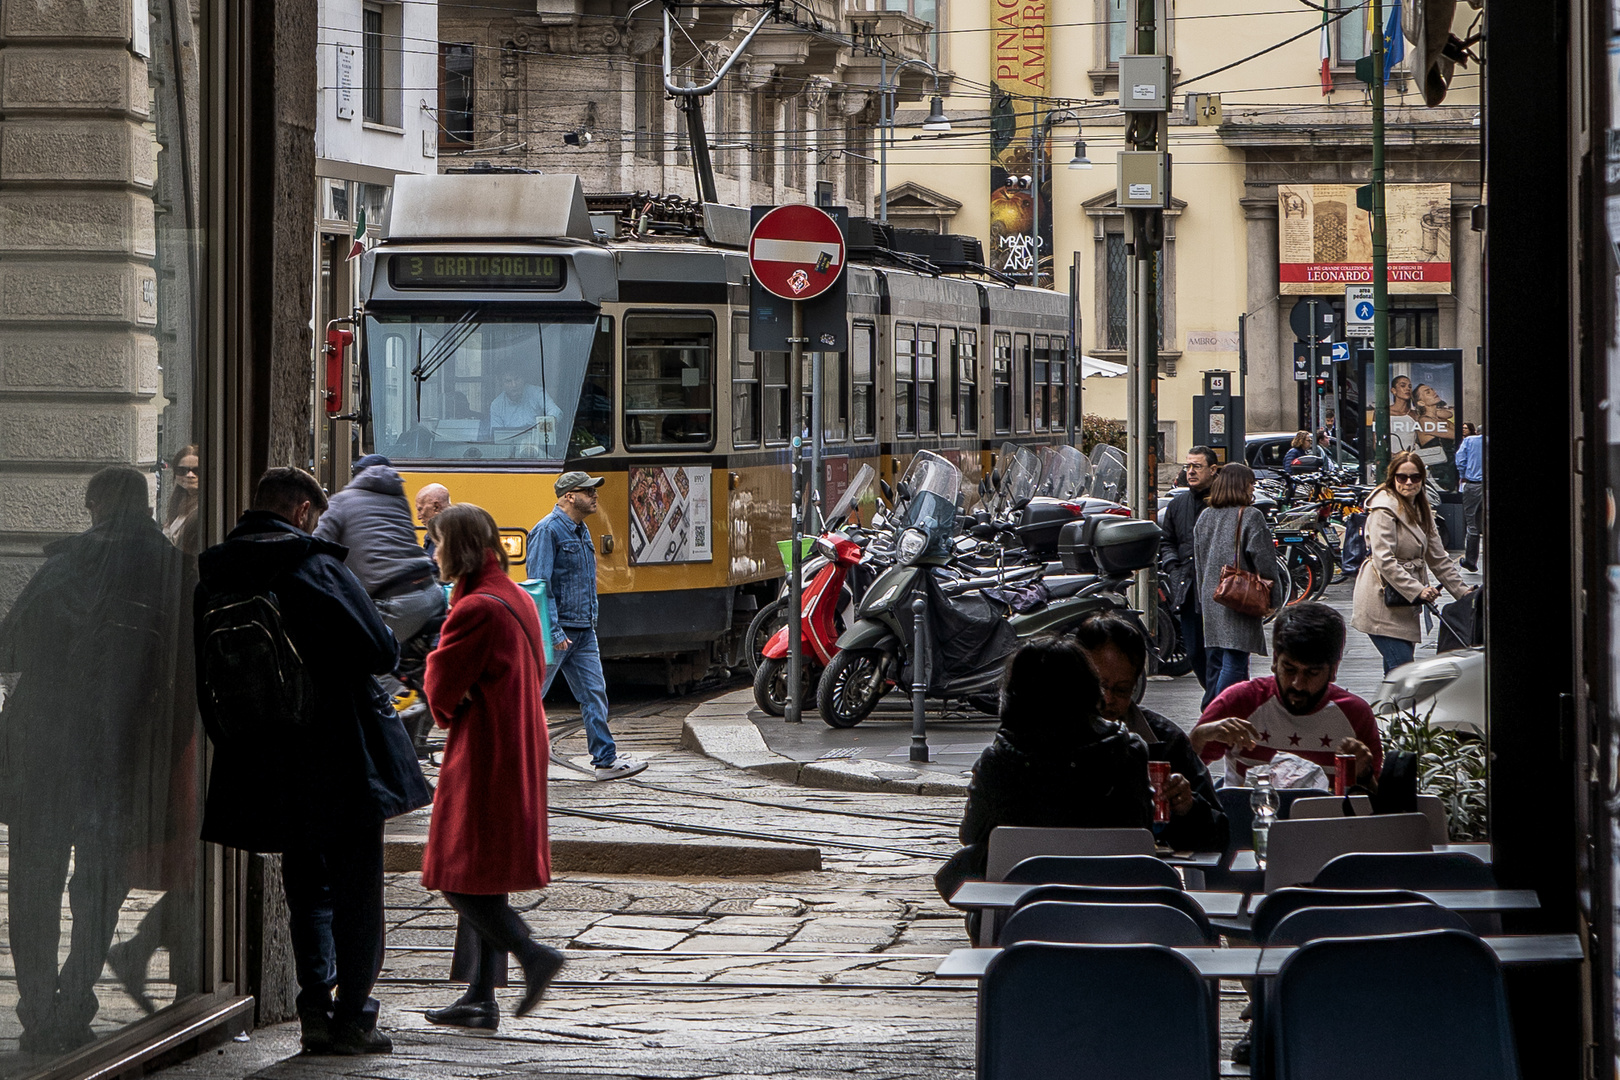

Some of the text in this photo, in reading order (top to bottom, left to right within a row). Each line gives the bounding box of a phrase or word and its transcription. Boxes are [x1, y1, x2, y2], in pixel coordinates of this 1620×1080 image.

[1023, 0, 1045, 90] AMBR
[410, 257, 553, 276] 3 GRATOSOGLIO
[1308, 271, 1423, 281] LEONARDO VINCI
[1213, 379, 1222, 387] 45
[1372, 421, 1448, 433] RIADE
